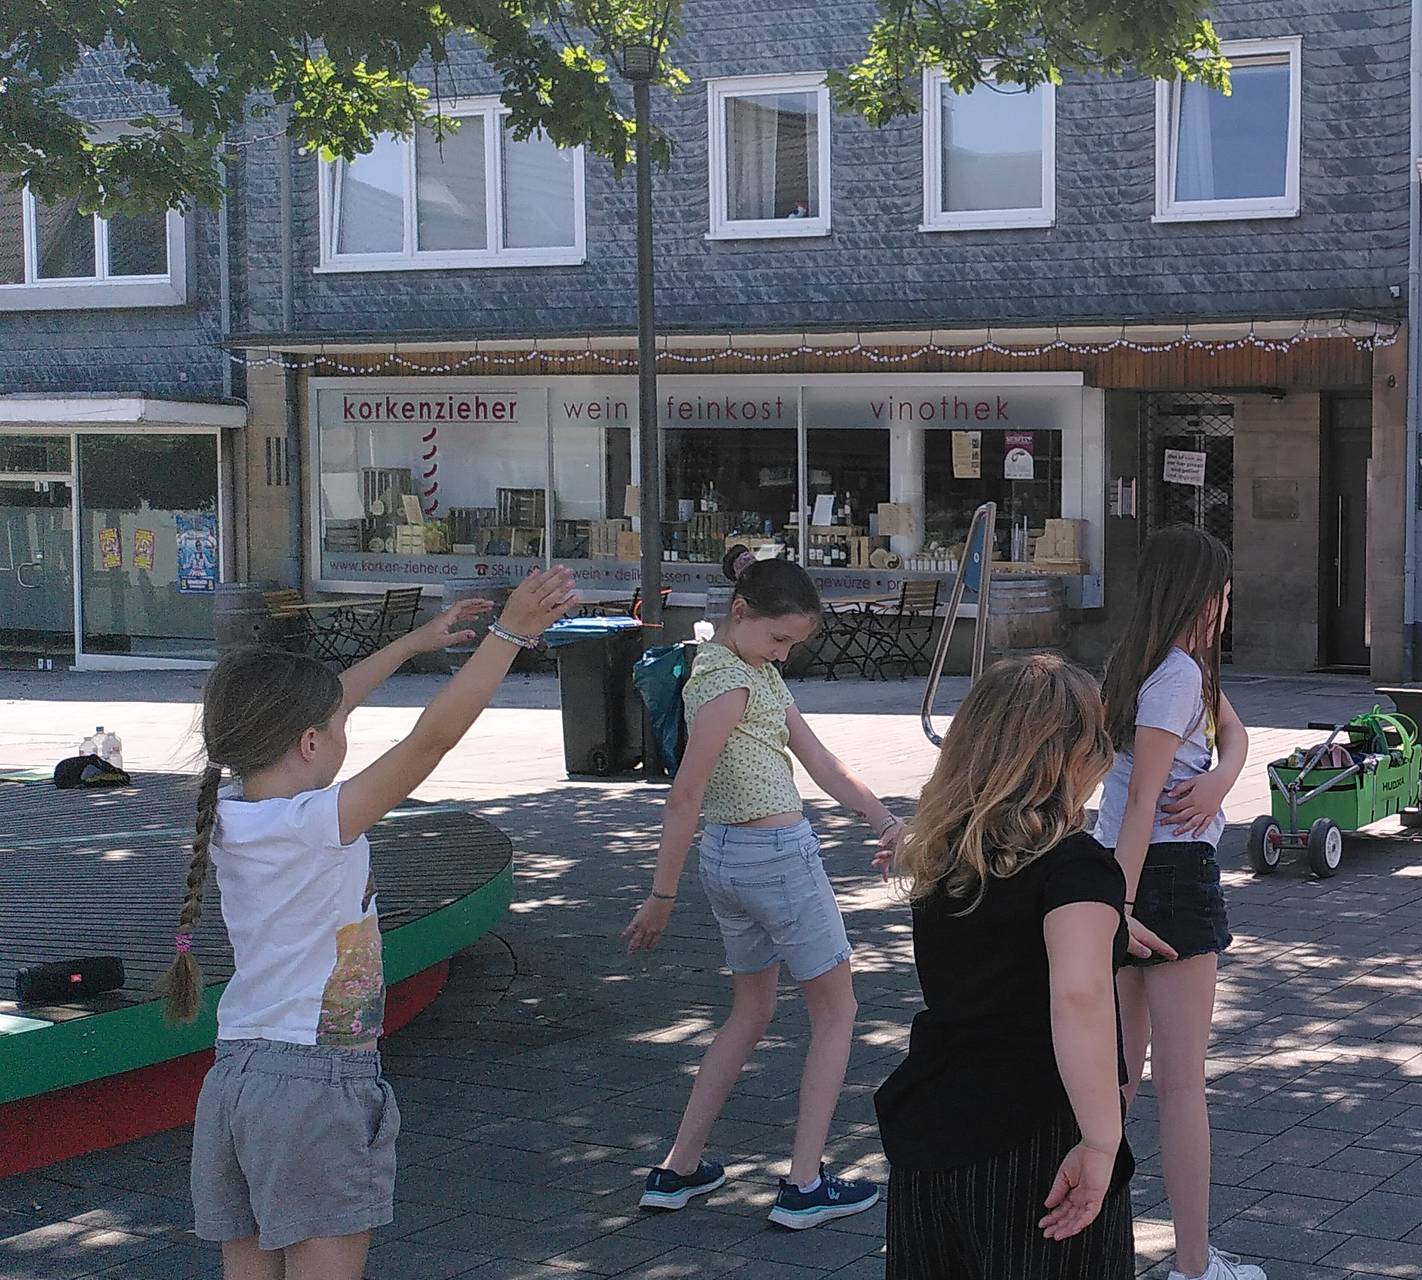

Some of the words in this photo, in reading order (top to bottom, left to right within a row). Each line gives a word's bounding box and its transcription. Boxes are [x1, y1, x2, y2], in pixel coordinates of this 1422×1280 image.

[1388, 375, 1396, 388] 8
[343, 396, 518, 420] korkenzieher
[563, 398, 628, 420] wein
[667, 395, 784, 421] feinkost
[870, 395, 1010, 422] vinothek
[329, 560, 458, 576] www.korken-zieher.de
[572, 566, 600, 581] wein
